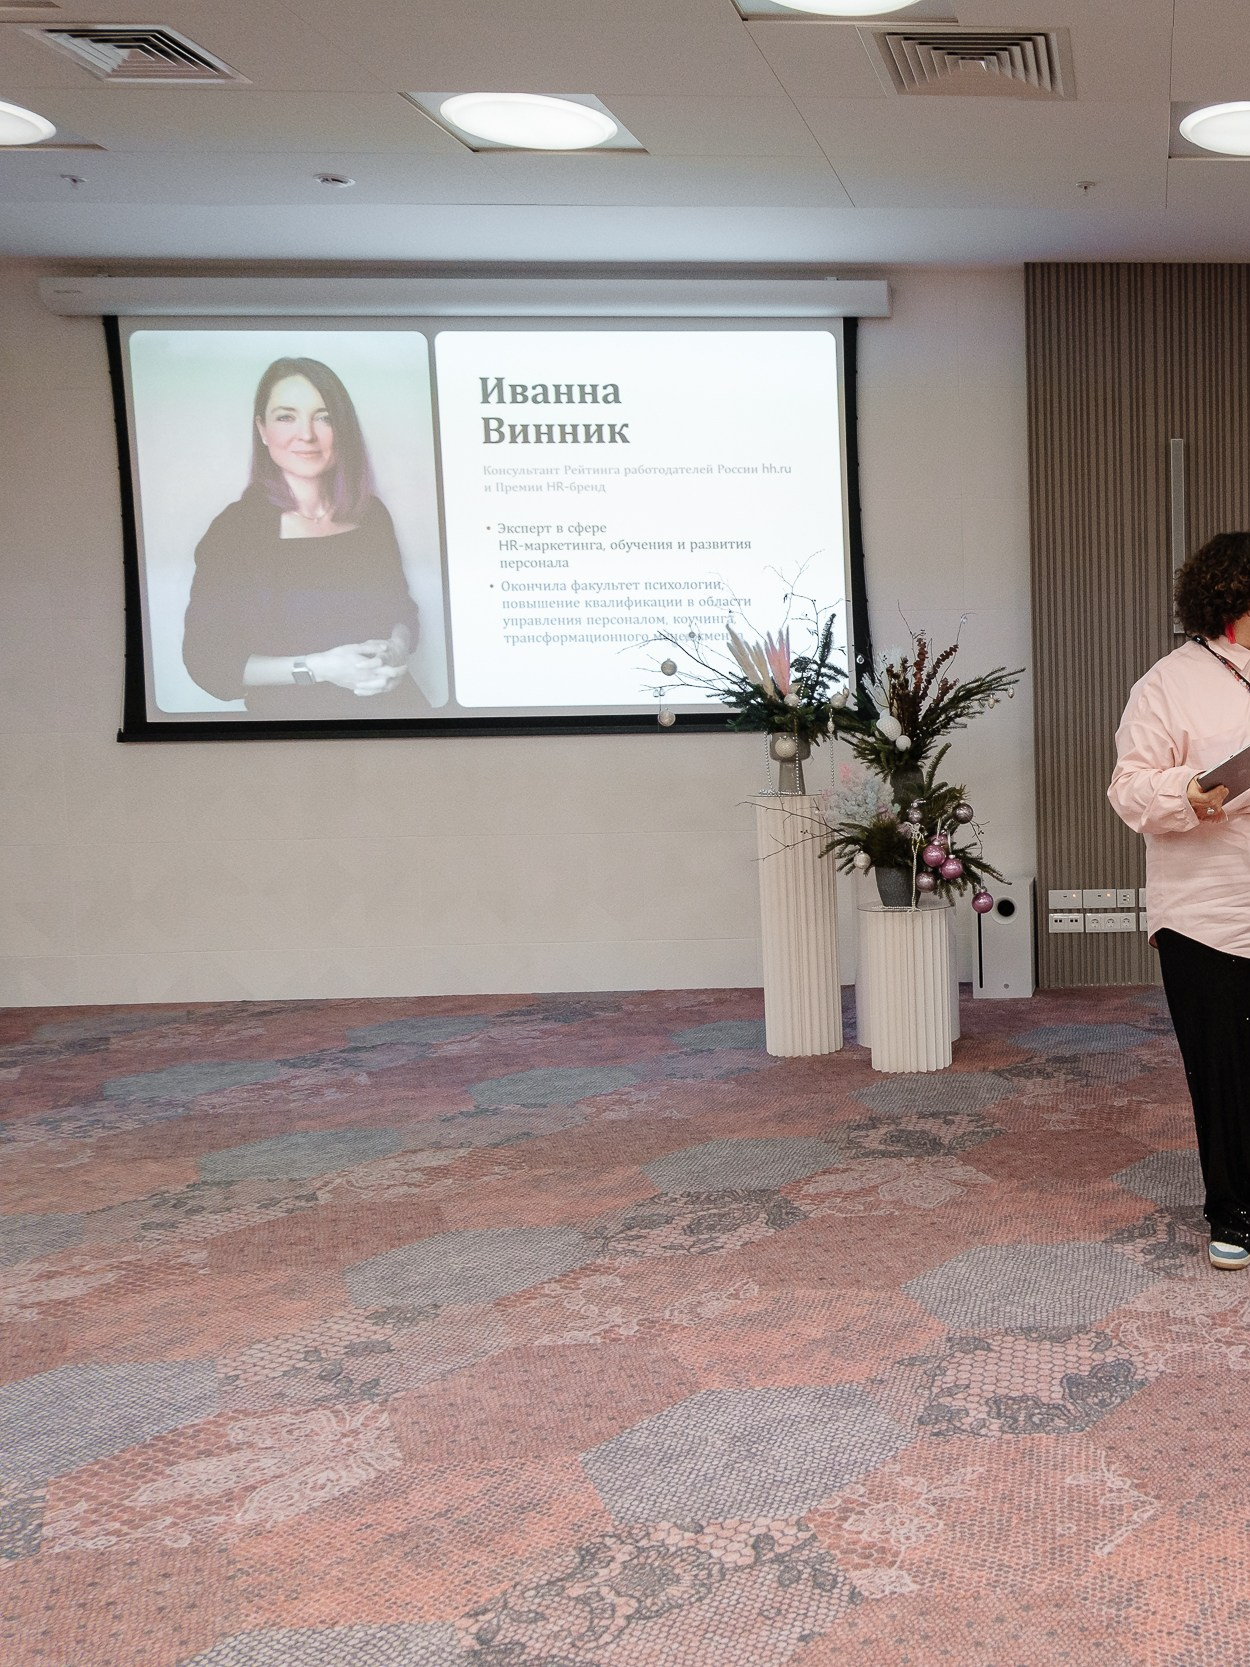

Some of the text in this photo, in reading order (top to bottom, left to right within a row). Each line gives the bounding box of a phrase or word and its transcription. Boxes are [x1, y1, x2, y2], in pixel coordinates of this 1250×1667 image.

[479, 376, 623, 404] Иванна
[481, 416, 631, 444] Винник
[484, 462, 792, 478] Консультант Рейтинга работодателей России hh.ru
[483, 480, 607, 494] и Премии HR-бренд
[498, 521, 607, 536] Эксперт в сфере
[499, 538, 752, 553] HR-маркетинга, обучения и развития
[500, 559, 570, 571] персонала
[501, 580, 725, 592] Окончила факультет психологии,
[503, 595, 751, 610] повышение квалификации в области
[503, 616, 582, 629] управления
[587, 615, 669, 628] персоналом,
[504, 632, 649, 647] трансформационного
